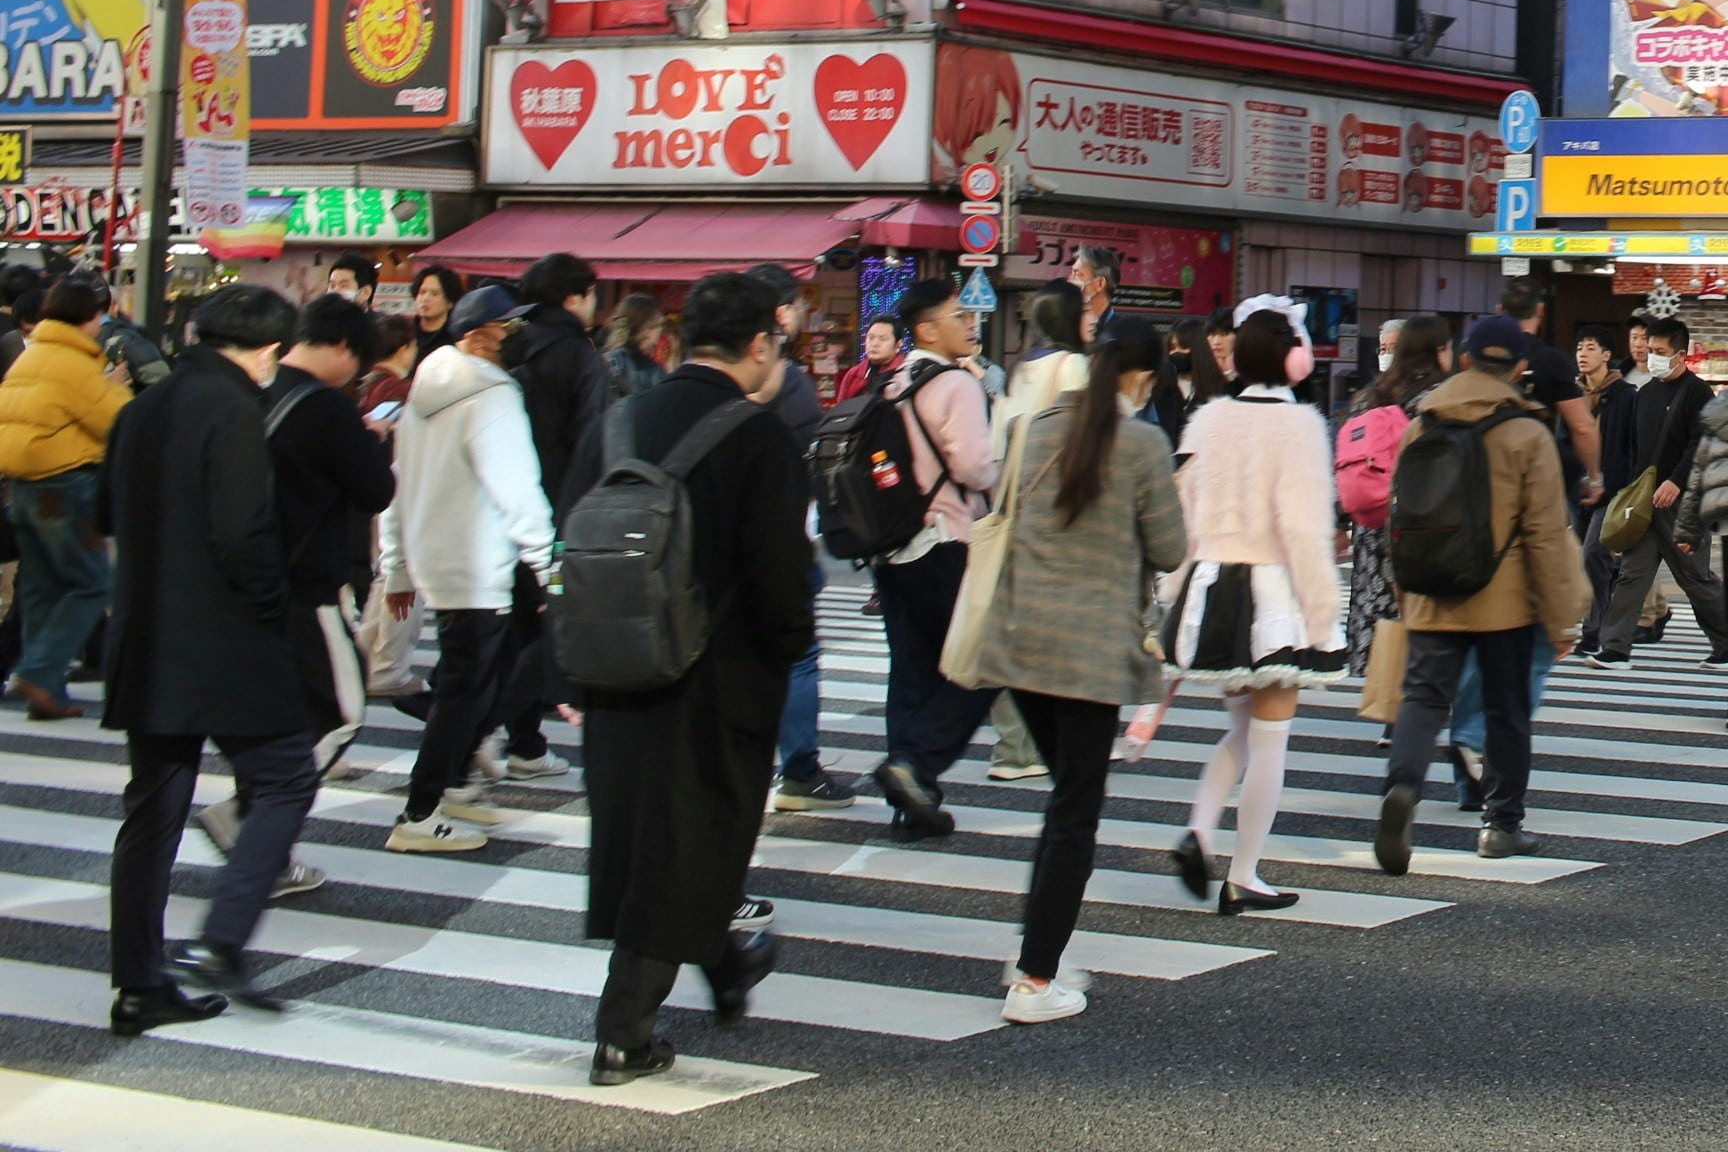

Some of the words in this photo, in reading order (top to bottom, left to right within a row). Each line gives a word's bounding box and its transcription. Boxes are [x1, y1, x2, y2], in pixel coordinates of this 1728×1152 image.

[520, 87, 584, 113] 秋葉原
[1035, 92, 1183, 146] 大人の通信販売
[1508, 106, 1525, 144] P
[1508, 186, 1529, 231] P
